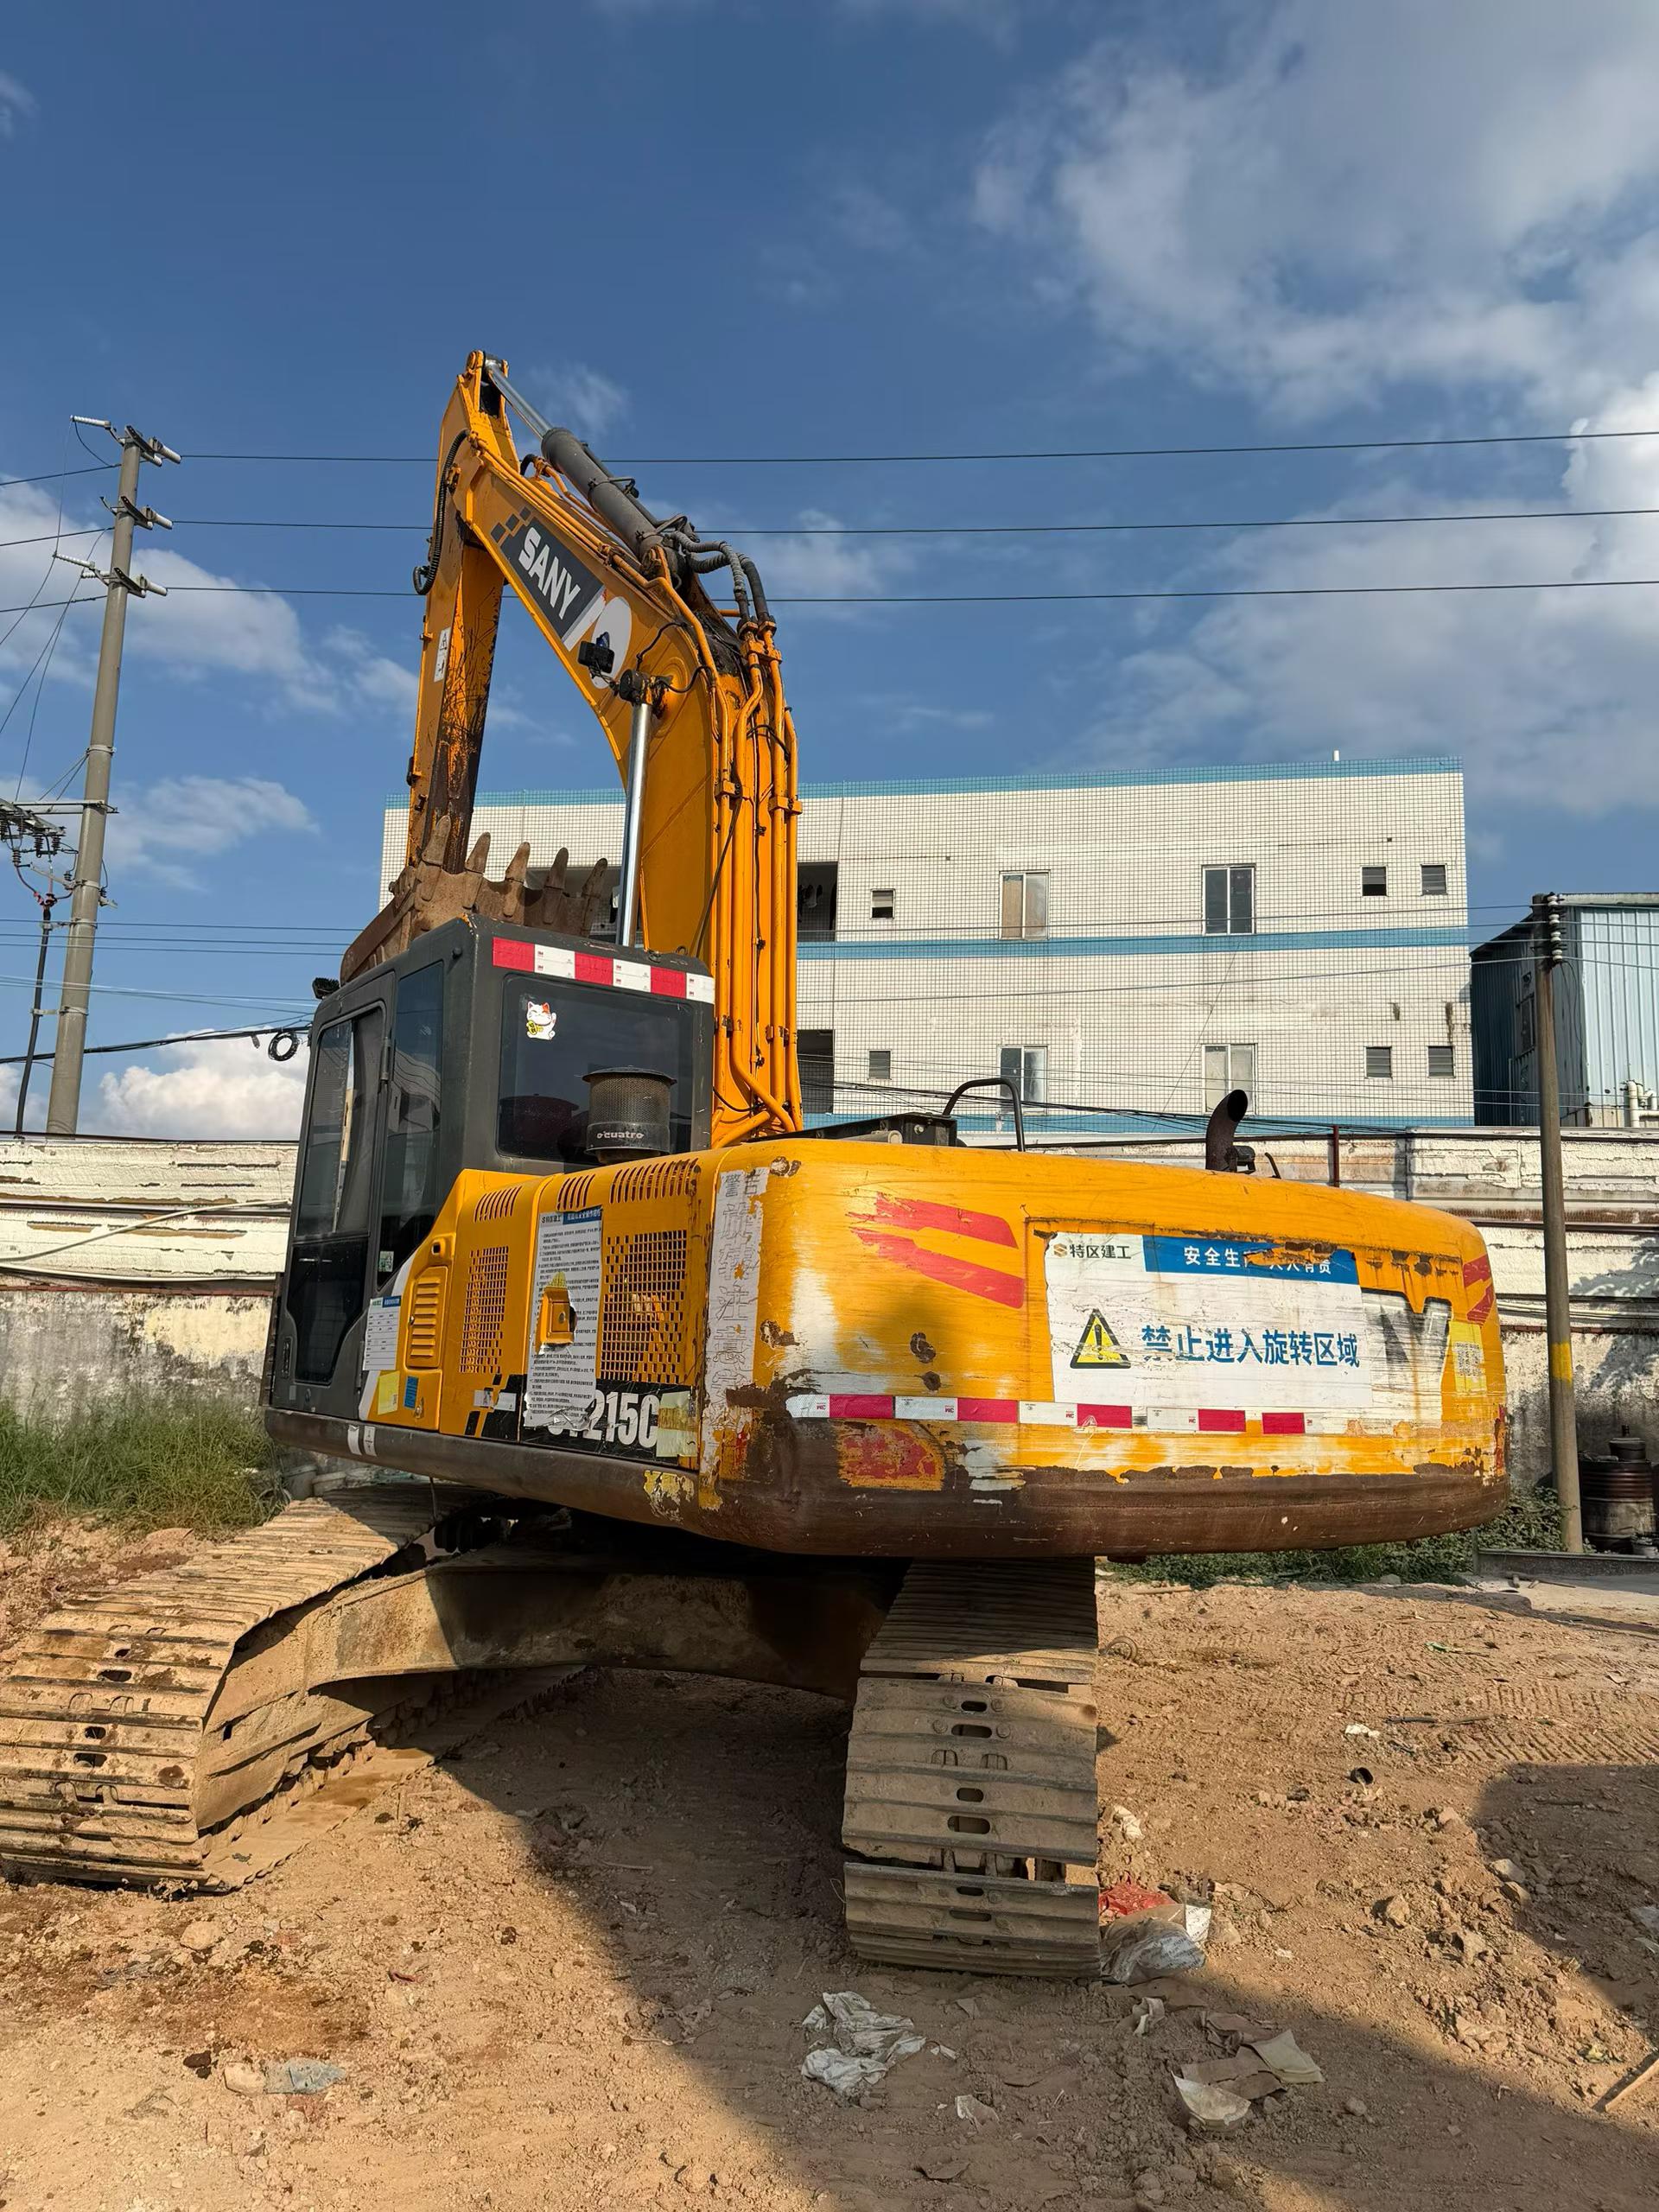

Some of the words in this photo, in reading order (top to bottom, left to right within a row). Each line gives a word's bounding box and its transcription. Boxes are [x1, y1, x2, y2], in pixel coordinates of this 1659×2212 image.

[518, 526, 581, 620] SANY
[1070, 1244, 1132, 1260] 特区建工
[1141, 1325, 1360, 1368] 禁止进入旋转区域
[548, 1389, 659, 1448] 215C
